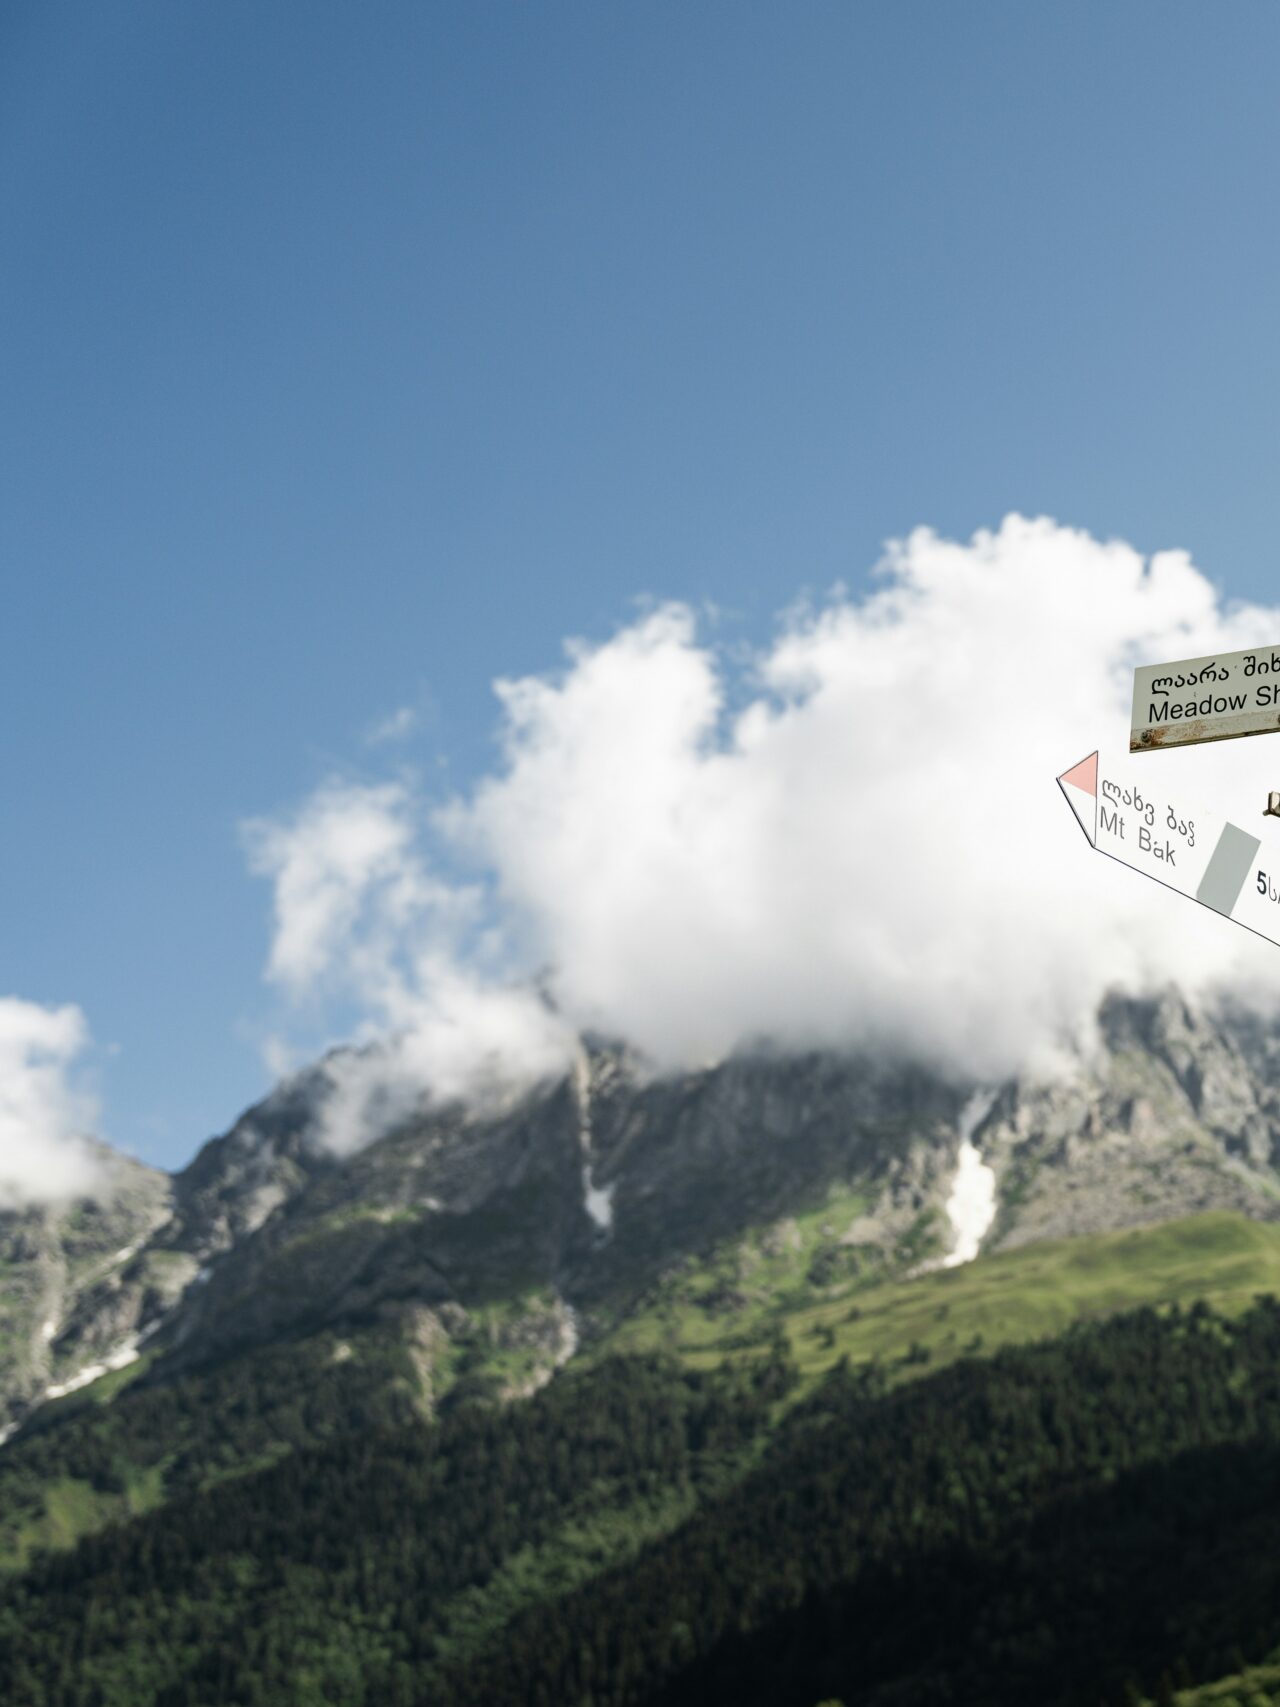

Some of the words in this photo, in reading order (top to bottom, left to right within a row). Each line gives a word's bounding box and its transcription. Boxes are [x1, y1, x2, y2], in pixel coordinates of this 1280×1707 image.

[1148, 694, 1248, 724] Meadow
[1100, 805, 1126, 840] Mt
[1138, 826, 1177, 867] Bak
